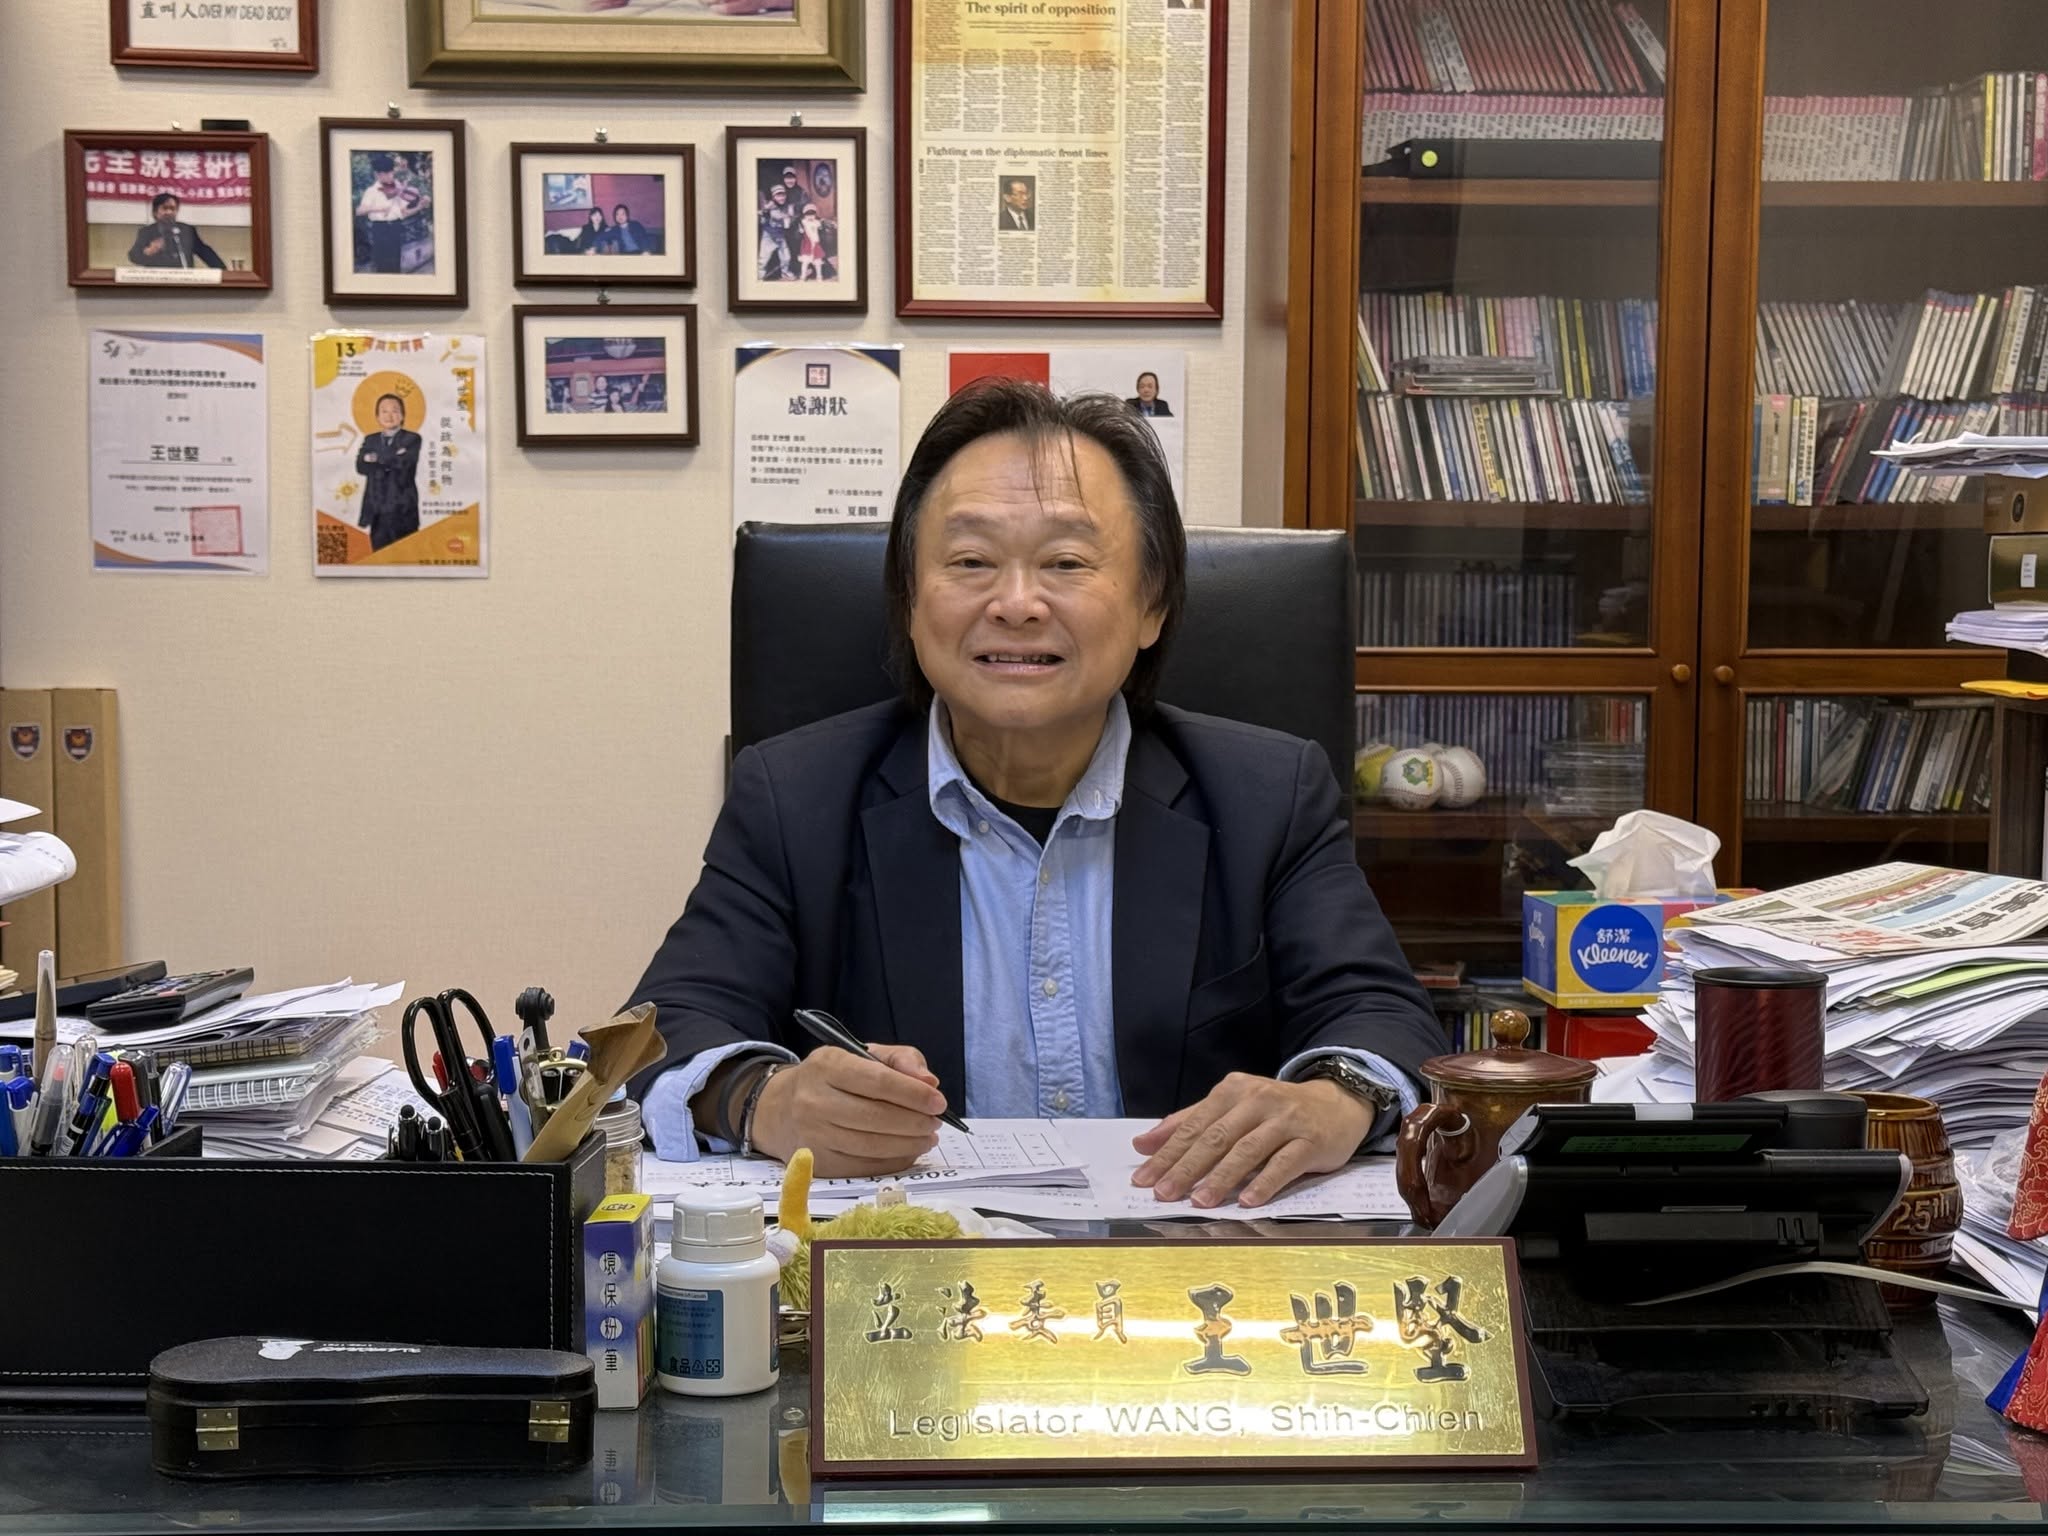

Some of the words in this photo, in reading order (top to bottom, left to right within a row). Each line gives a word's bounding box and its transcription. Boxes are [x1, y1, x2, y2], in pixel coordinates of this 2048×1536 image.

[199, 4, 222, 19] OVER
[224, 6, 238, 19] MY
[239, 6, 265, 20] DEAD
[267, 6, 292, 21] BODY
[966, 2, 992, 14] The
[994, 3, 1028, 16] spirit
[1032, 3, 1047, 14] of
[1049, 3, 1117, 17] opposition
[926, 147, 968, 158] Fighting
[970, 149, 983, 157] on
[985, 147, 1001, 157] the
[1003, 147, 1056, 159] diplomatic
[1058, 148, 1082, 158] front
[1085, 148, 1109, 158] lines
[336, 342, 356, 358] 13
[788, 396, 848, 416] 感謝狀
[151, 445, 199, 462] 王世堅
[1596, 928, 1631, 945] 舒潔
[1577, 943, 1649, 970] Kleenex
[864, 1279, 1129, 1344] 立法委員
[1182, 1274, 1495, 1384] 王世堅
[889, 1407, 1083, 1443] Legislator
[1110, 1406, 1246, 1437] WANG,
[1271, 1404, 1484, 1434] Shih-Chien
